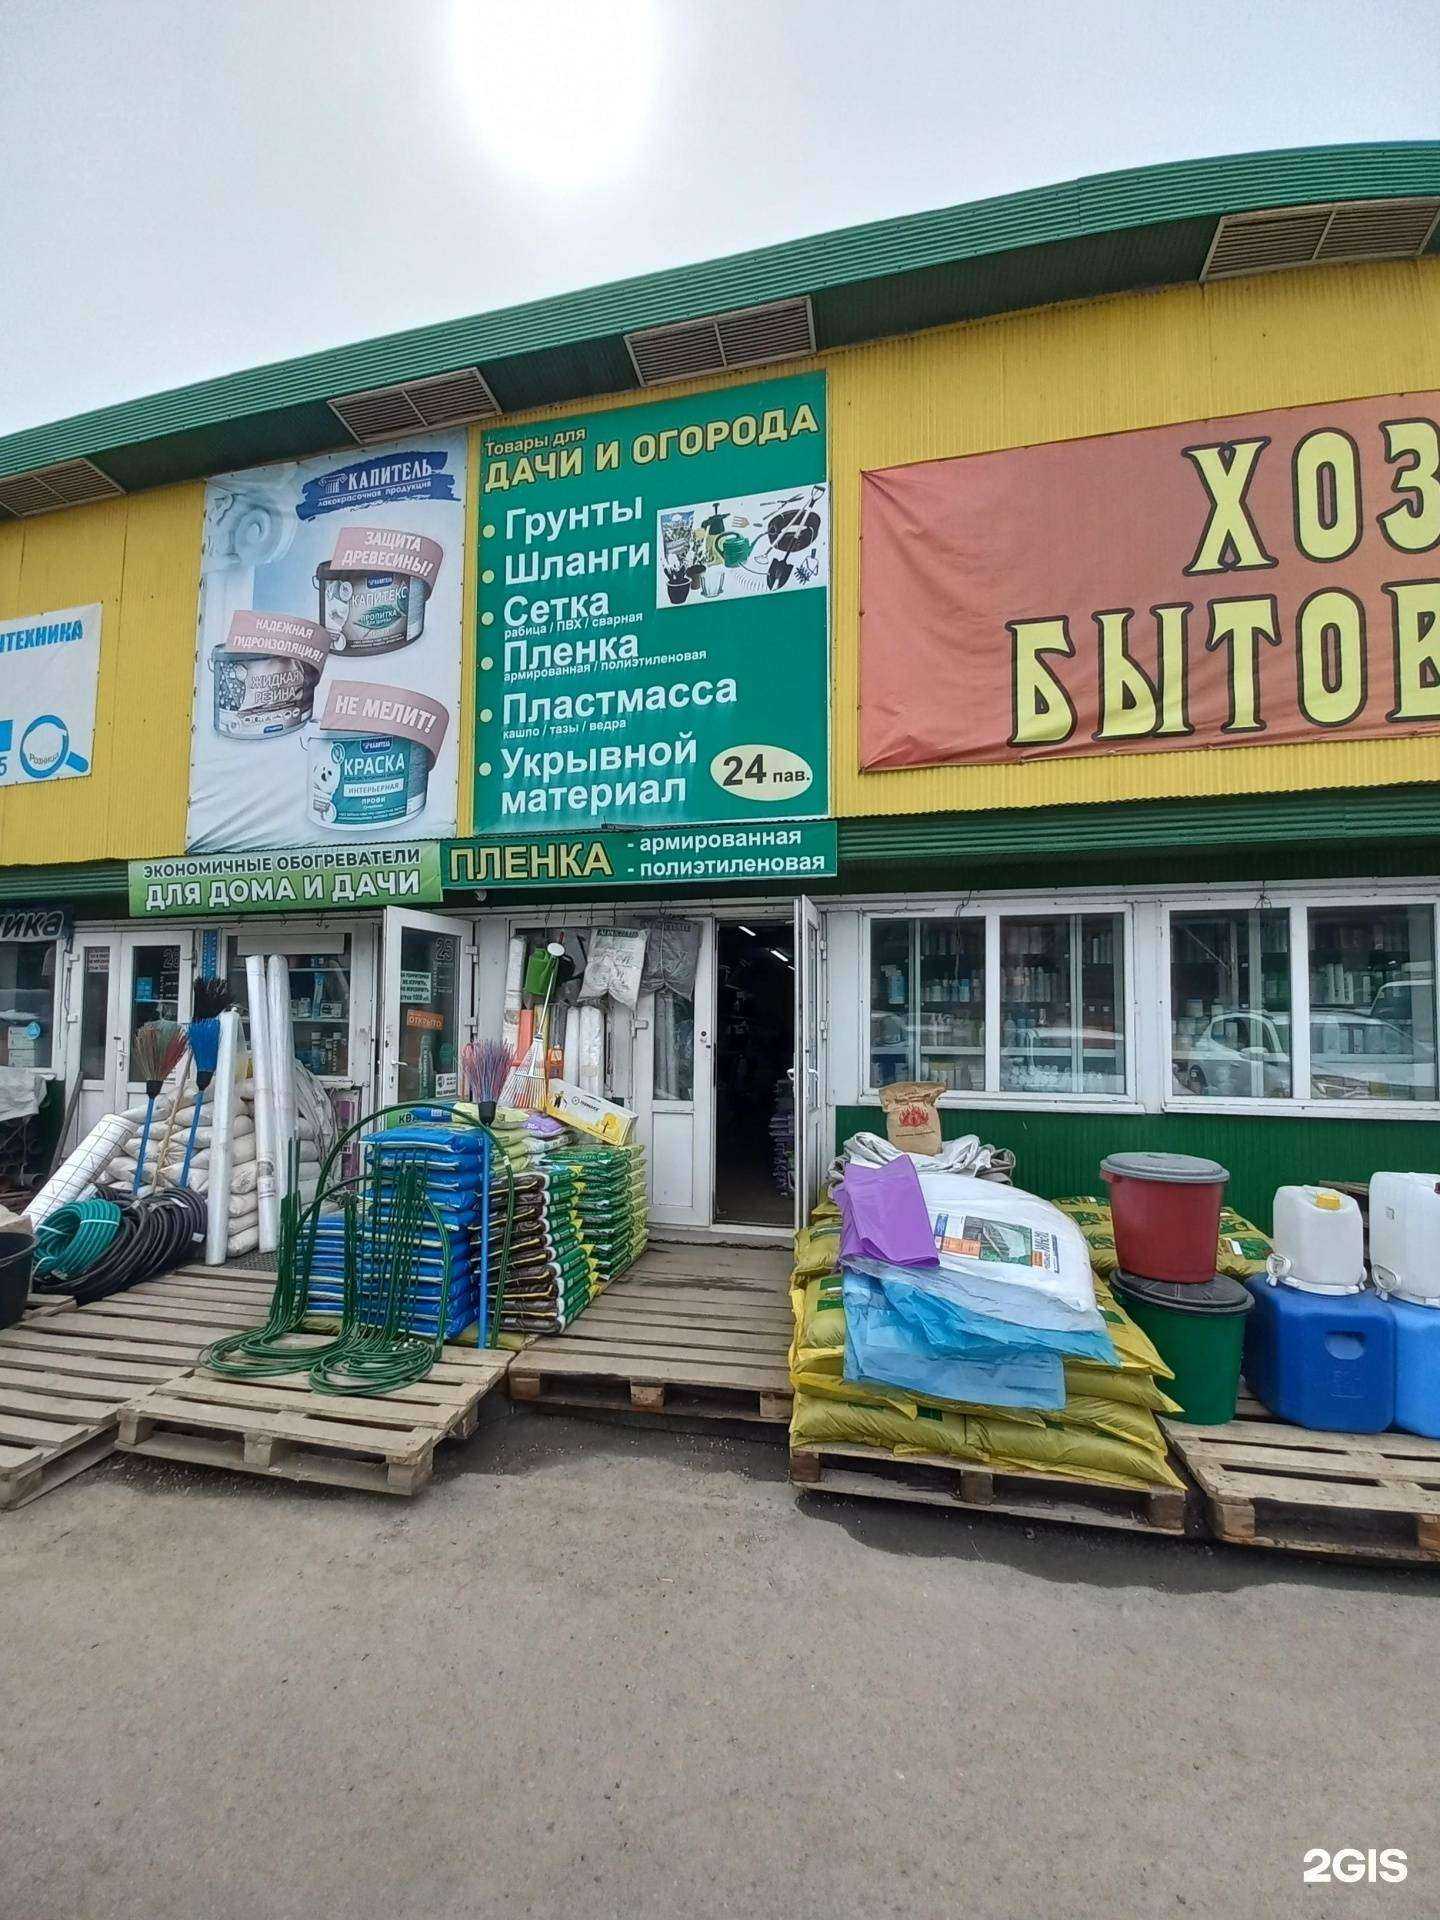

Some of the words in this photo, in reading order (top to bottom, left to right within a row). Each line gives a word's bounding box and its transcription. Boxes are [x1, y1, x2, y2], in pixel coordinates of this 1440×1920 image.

[484, 436, 548, 457] Товары
[552, 428, 586, 447] для
[484, 446, 583, 493] ДАЧИ
[595, 441, 619, 472] И
[632, 404, 819, 465] ОГОРОДА
[348, 458, 432, 490] КАПИТЕЛЬ
[317, 490, 382, 507] лакокрасочная
[385, 480, 432, 497] продукция
[1182, 418, 1440, 575] ХОЗ
[505, 496, 642, 544] Грунты
[364, 531, 422, 551] ЗАЩИТА
[341, 550, 433, 577] ДРЕВЕСИНЫ!
[505, 542, 650, 585] Шланги
[352, 586, 408, 607] КАПИТЕКС
[504, 592, 610, 627] Сетка
[256, 618, 314, 639] НАДЕЖНАЯ
[504, 623, 547, 640] рабица
[557, 618, 582, 632] ПВХ
[592, 613, 643, 629] сварная
[232, 635, 323, 662] ГИДРОИЗОЛЯЦИЯ!
[504, 633, 639, 673] Пленка
[1006, 578, 1440, 747] БЫТОВ
[250, 671, 299, 690] ЖИДКАЯ
[504, 664, 590, 683] армированная
[601, 650, 707, 671] полиэтиленовая
[254, 686, 297, 704] РЕЗИНА
[503, 678, 738, 725] Пластмасса
[335, 695, 360, 715] НЕ
[363, 698, 437, 733] МЕЛИТ!
[502, 726, 540, 740] кашпо
[549, 724, 579, 735] тазы
[589, 718, 626, 732] ведра
[344, 753, 405, 776] КРАСКА
[501, 731, 697, 783] Укрывной
[723, 753, 767, 787] 24
[773, 769, 810, 783] пав.
[502, 777, 687, 815] материал
[639, 829, 801, 854] армированная
[143, 857, 272, 879] ЭКОНОМИЧНЫЕ
[277, 848, 420, 871] ОБОГРЕВАТЕЛИ
[450, 841, 615, 882] ПЛЕНКА
[640, 855, 825, 877] полиэтиленовая
[145, 881, 201, 911] ДЛЯ
[208, 876, 297, 908] ДОМА
[303, 873, 324, 900] И
[331, 870, 421, 902] ДАЧИ
[0, 911, 64, 938] ика
[436, 937, 454, 960] 25
[409, 1016, 442, 1028] ОТКРЫТО
